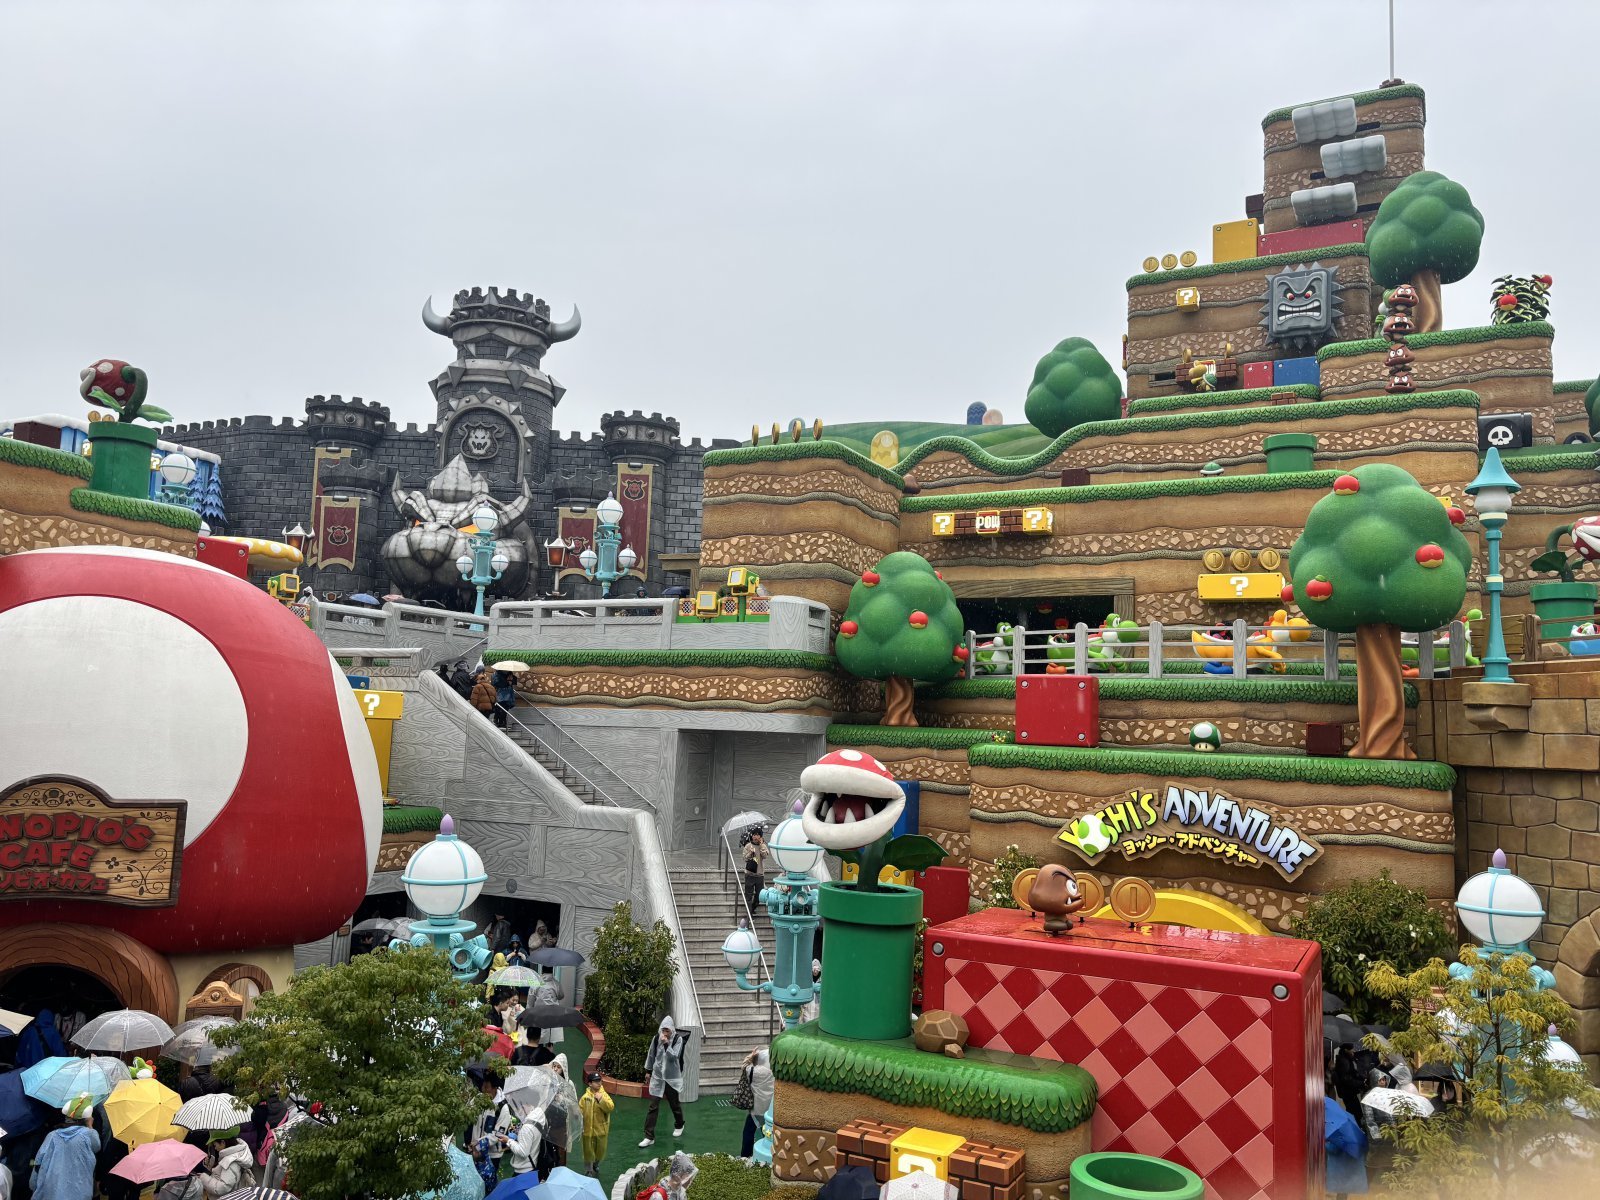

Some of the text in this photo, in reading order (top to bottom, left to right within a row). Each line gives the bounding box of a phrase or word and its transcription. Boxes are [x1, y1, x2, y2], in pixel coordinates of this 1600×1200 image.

[935, 515, 951, 533] ?
[975, 515, 1000, 529] POW
[1026, 510, 1042, 529] ?
[1229, 576, 1249, 596] ?
[364, 693, 380, 716] ?
[1163, 786, 1317, 874] ADVENTURE
[0, 841, 98, 871] CAFE
[1122, 832, 1258, 864] ヨッシー・アドベンチャー
